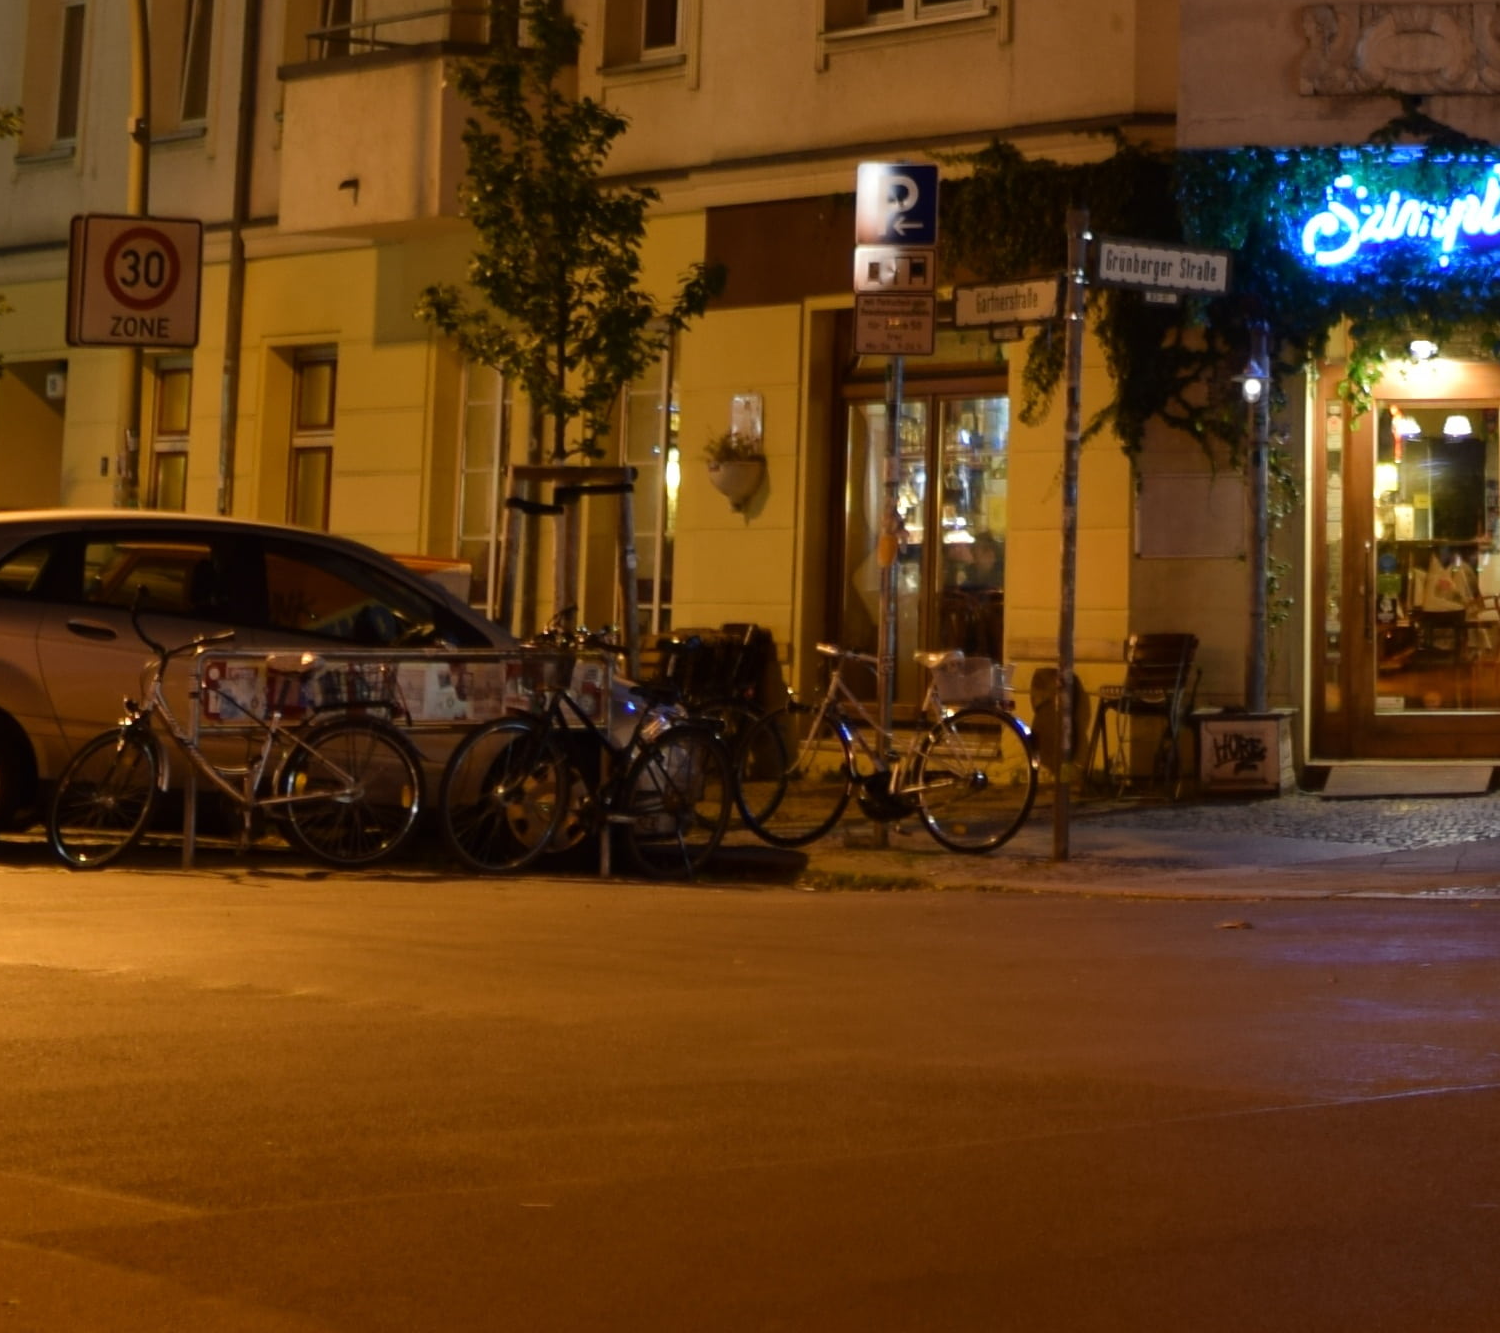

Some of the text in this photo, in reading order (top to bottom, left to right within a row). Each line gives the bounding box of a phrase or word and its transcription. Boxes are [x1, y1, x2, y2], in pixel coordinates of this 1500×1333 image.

[120, 249, 165, 288] 30
[1105, 249, 1174, 282] Grünberger
[109, 316, 170, 339] ZONE
